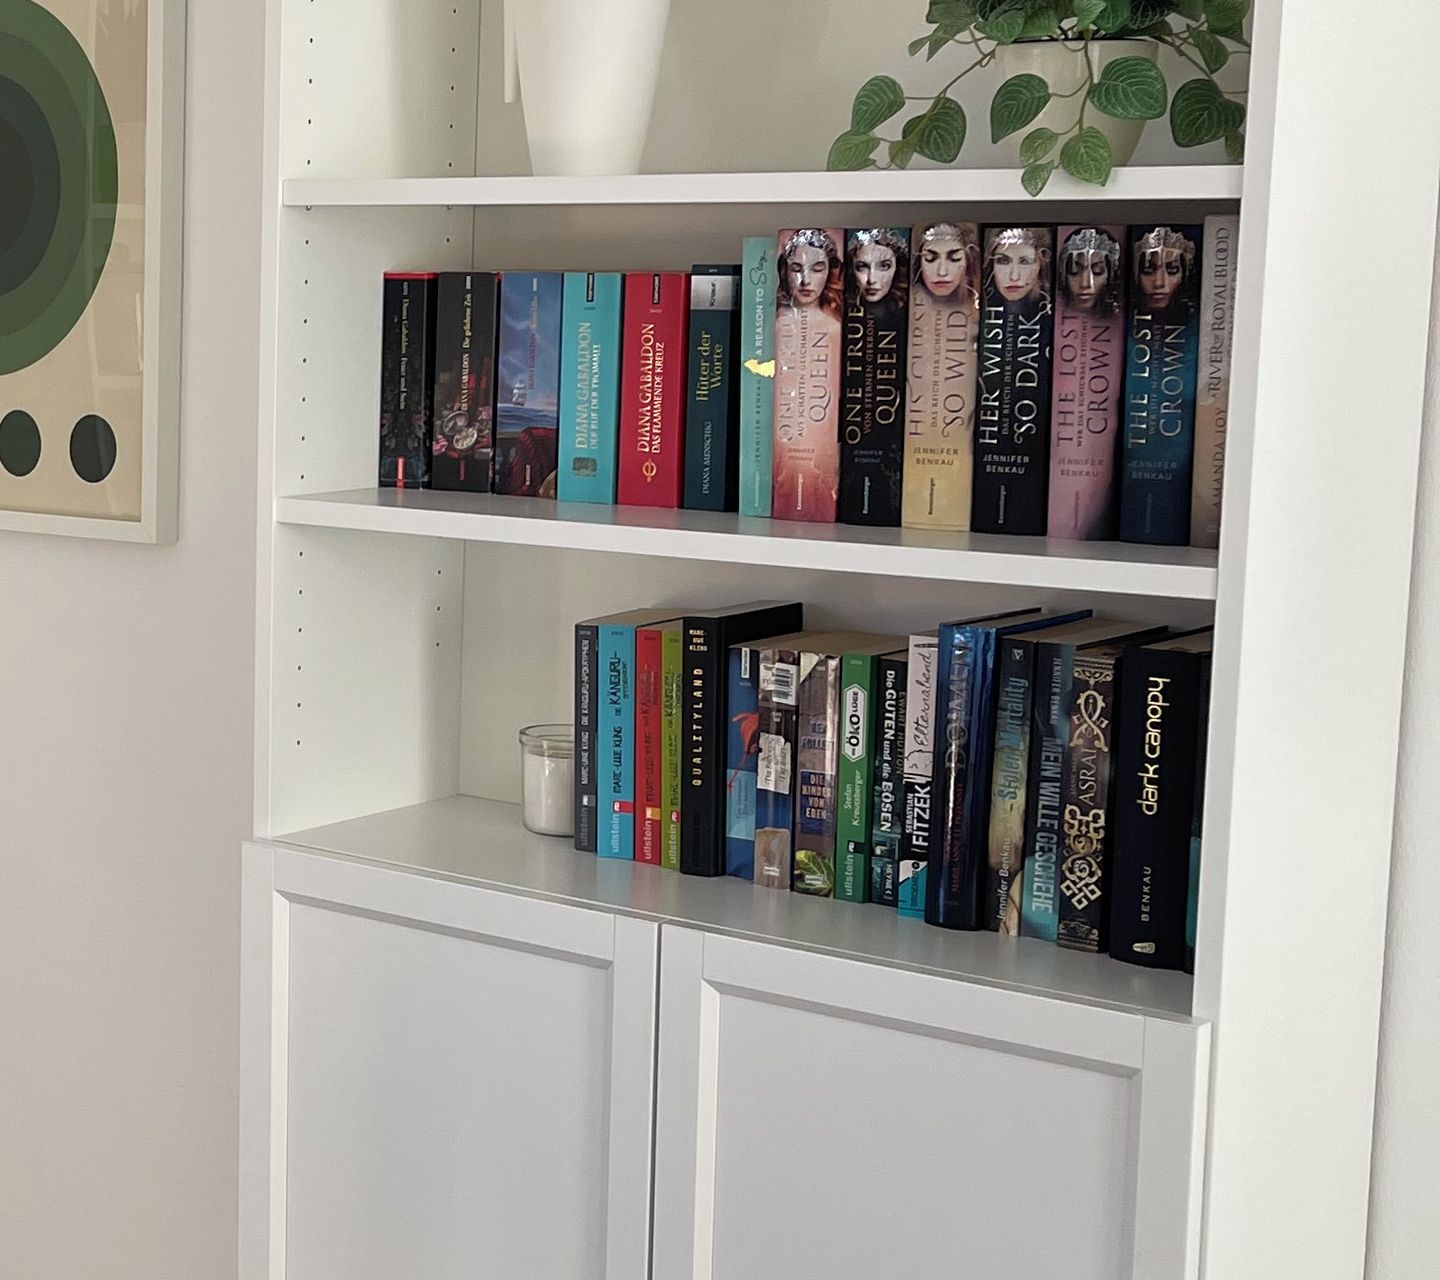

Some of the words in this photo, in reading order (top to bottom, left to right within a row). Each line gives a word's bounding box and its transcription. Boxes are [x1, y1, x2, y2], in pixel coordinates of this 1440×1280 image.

[1213, 227, 1230, 278] BLOOD
[756, 288, 764, 303] TO
[1211, 282, 1229, 332] ROYAL
[698, 330, 711, 357] der
[755, 304, 764, 347] REASON
[846, 305, 864, 377] TRUE
[944, 309, 969, 382] WILD
[982, 305, 1004, 377] WISH
[1058, 310, 1079, 376] LOST
[1131, 309, 1152, 379] LOST
[576, 322, 591, 401] GABALDON
[639, 323, 655, 404] GABALDON
[655, 341, 665, 373] KREUZ
[710, 343, 724, 389] Worte
[1015, 314, 1042, 388] DARK
[1208, 342, 1224, 393] RIVER
[696, 361, 711, 402] Hüter
[809, 330, 831, 423] QUEEN
[875, 330, 901, 425] QUEEN
[1086, 323, 1111, 435] CROWN
[1160, 324, 1186, 437] CROWN
[575, 403, 589, 449] DIANA
[652, 375, 664, 434] FLAMMENDE
[846, 386, 862, 445] ONE
[863, 410, 872, 435] VON
[909, 395, 924, 437] HIS
[942, 393, 966, 439] SO
[979, 388, 1001, 445] HER
[1013, 400, 1037, 445] SO
[1056, 393, 1075, 447] THE
[1127, 393, 1150, 449] THE
[637, 407, 652, 453] DIANA
[652, 435, 661, 454] DAS
[913, 446, 959, 456] JENNIFER
[984, 453, 1030, 465] JENNIFER
[985, 464, 1026, 475] BENKAU
[885, 669, 895, 688] Die
[692, 667, 704, 787] QUALITYLAND
[883, 689, 897, 740] GUTEN
[1000, 676, 1028, 749] Mortality
[1144, 676, 1172, 759] canopy
[880, 762, 891, 780] die
[882, 740, 893, 761] und
[1040, 736, 1063, 778] MEIN
[843, 783, 853, 810] Stefan
[996, 751, 1021, 802] Stolen
[1075, 748, 1098, 806] ASRAI
[1136, 763, 1160, 816] dark
[805, 807, 827, 820] EDEN
[879, 781, 894, 832] BÖSEN
[905, 792, 914, 834] SEBASTIAN
[912, 784, 931, 847] FITZEK
[1036, 780, 1061, 829] WILLE
[610, 814, 620, 853] ullstein
[643, 820, 653, 860] ullstein
[668, 824, 678, 864] ullstein
[998, 837, 1013, 877] Benkau
[843, 854, 854, 897] ullstein
[1031, 831, 1056, 913] GESCHEHE
[1140, 865, 1153, 922] BENKAU
[995, 878, 1010, 923] Jennifer
